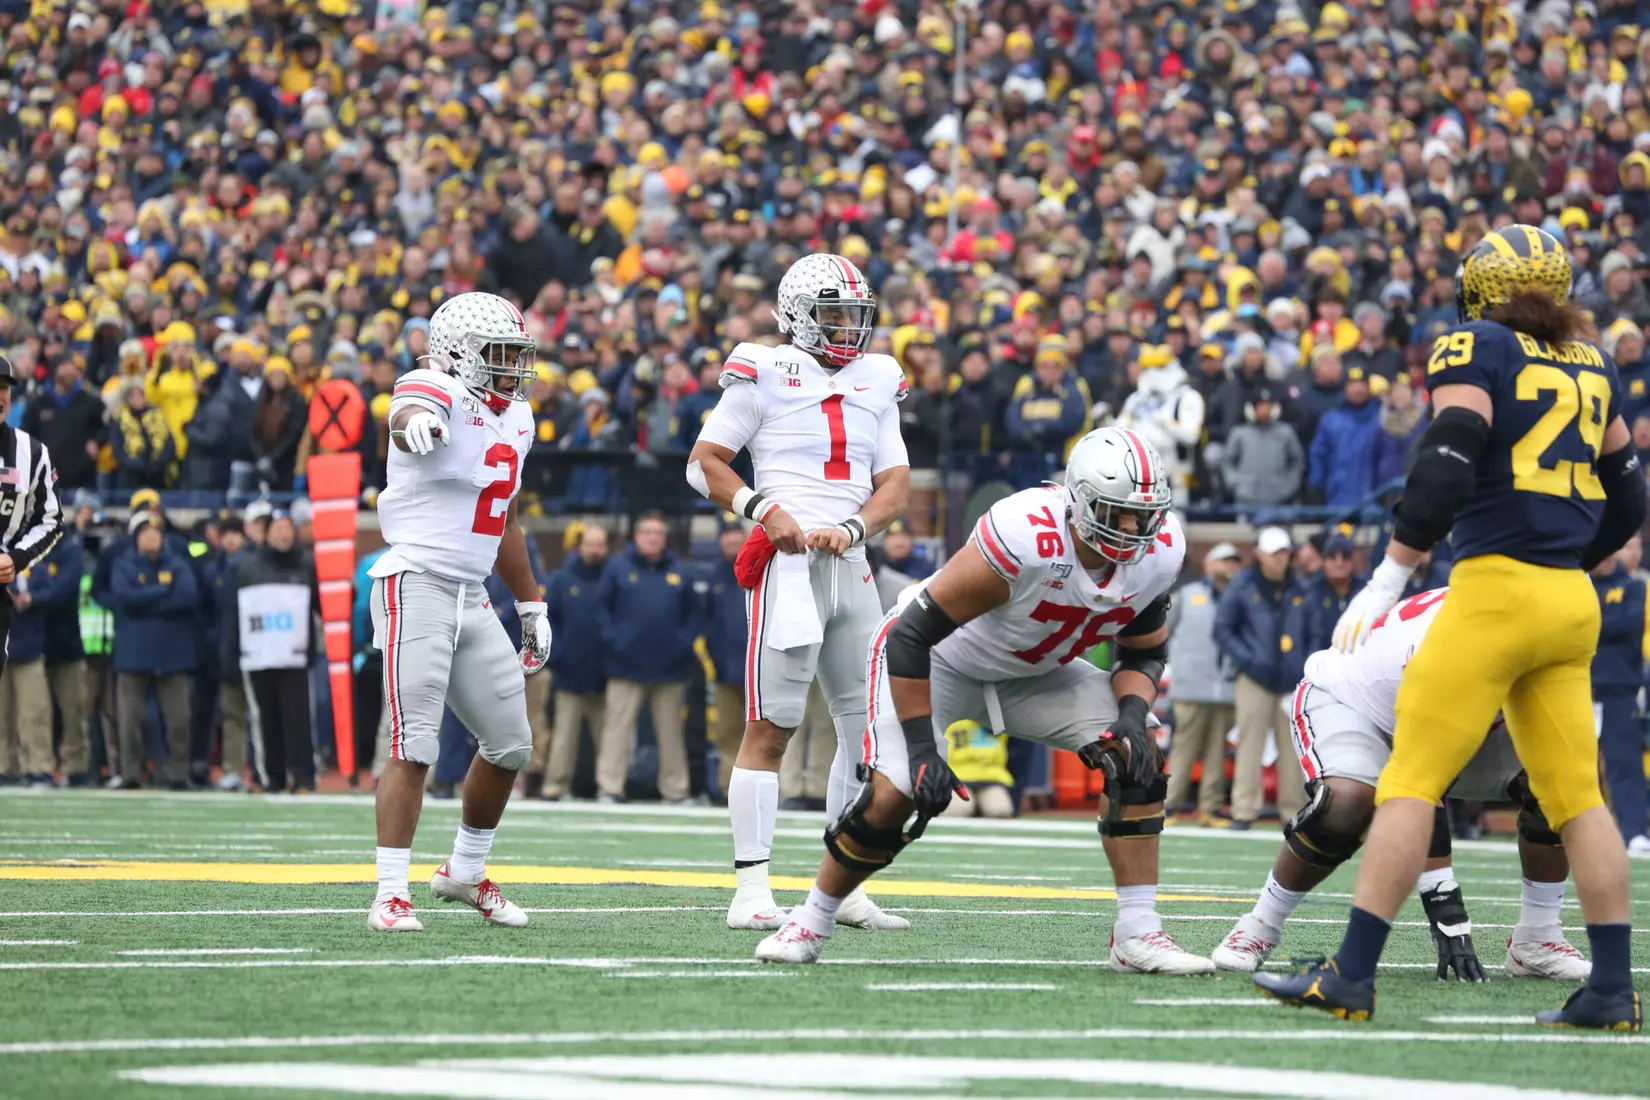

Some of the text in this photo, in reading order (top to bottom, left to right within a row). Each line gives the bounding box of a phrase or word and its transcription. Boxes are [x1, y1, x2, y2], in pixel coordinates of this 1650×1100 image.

[1427, 331, 1475, 375] 29
[820, 393, 851, 480] 1
[1511, 363, 1612, 500] 29
[471, 442, 519, 537] 2
[1026, 506, 1064, 559] 76
